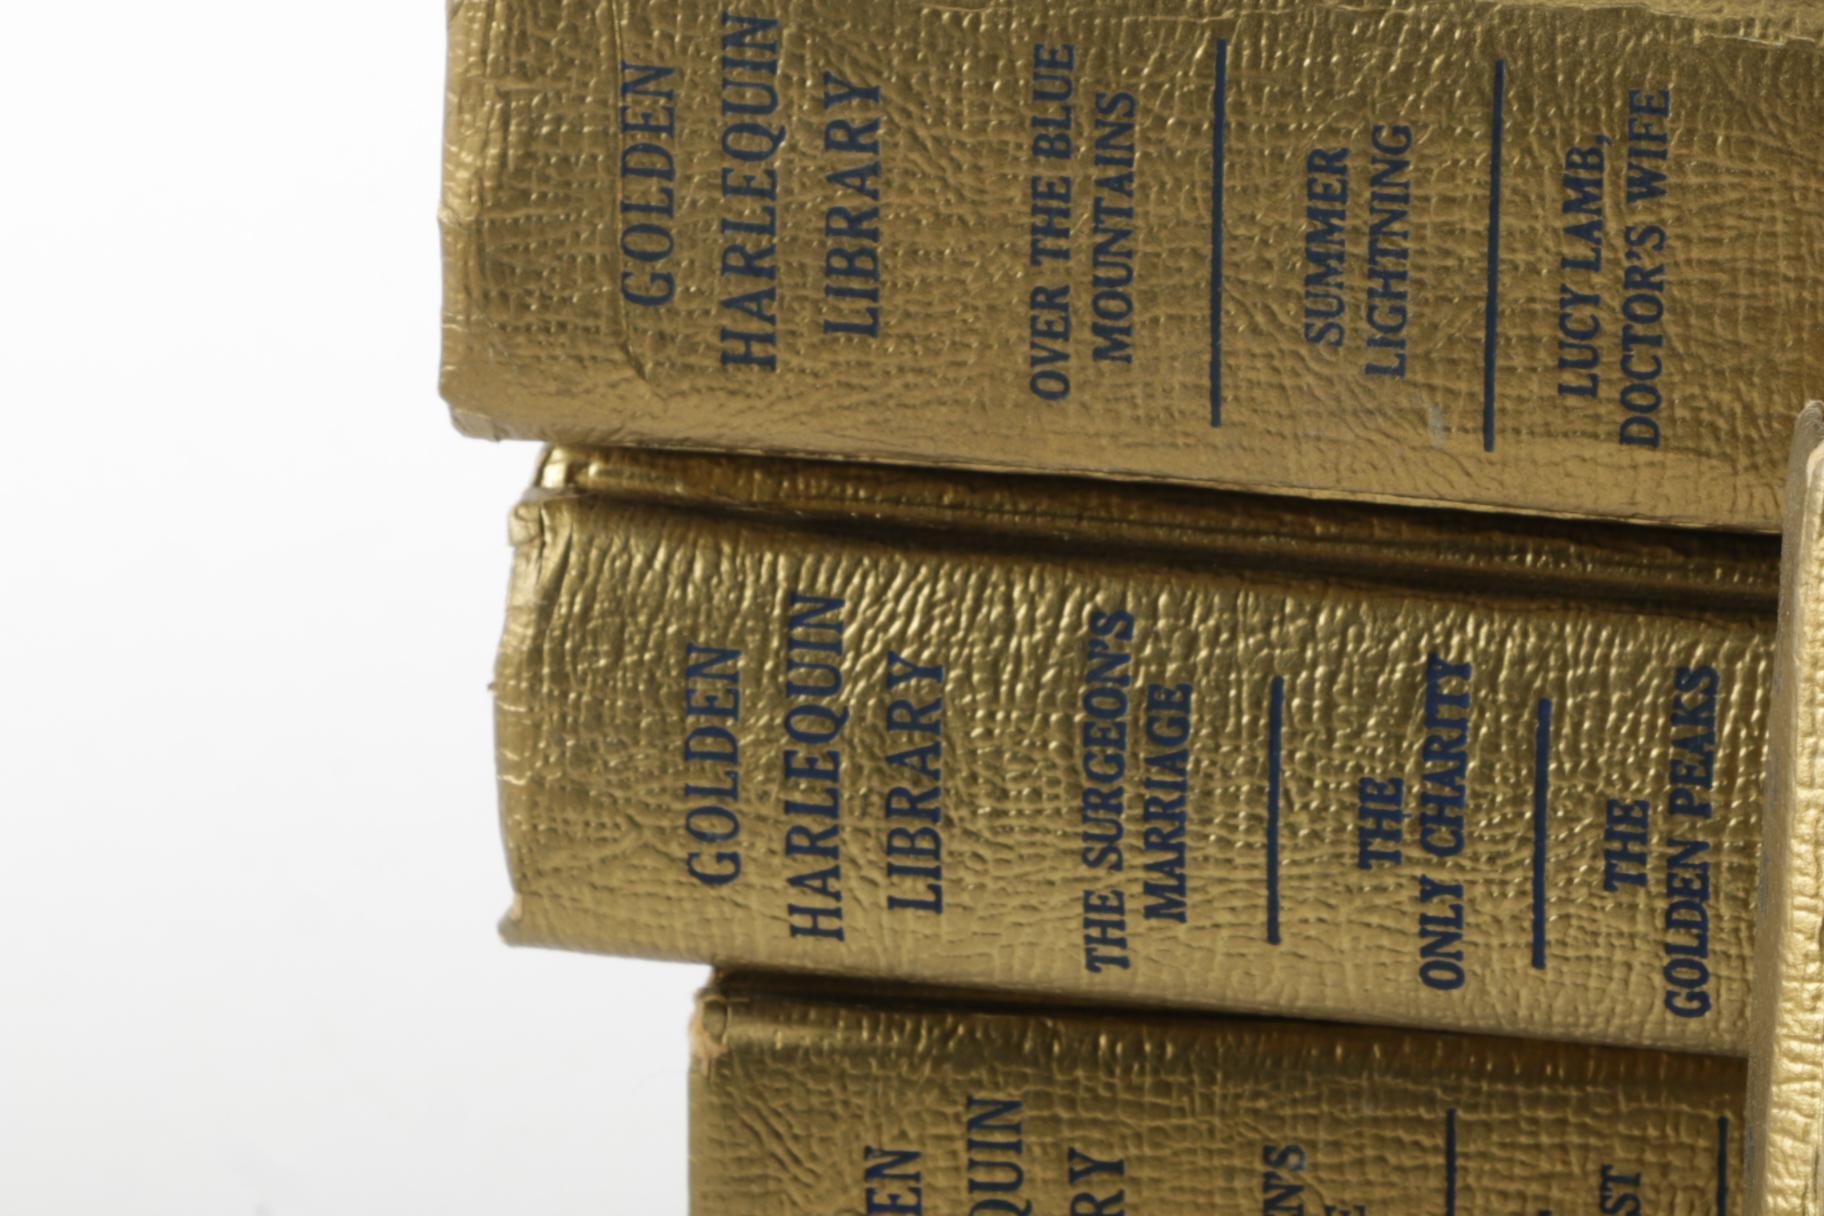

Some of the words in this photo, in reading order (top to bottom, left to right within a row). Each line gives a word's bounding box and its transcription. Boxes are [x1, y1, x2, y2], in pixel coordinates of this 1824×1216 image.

[619, 61, 677, 308] GOLDEN
[720, 11, 787, 370] HARLEQUIN
[1031, 43, 1076, 159] BLUE
[1627, 88, 1671, 204] WIFE
[822, 72, 883, 337] LIBRARY
[1030, 176, 1073, 267] THE
[1092, 91, 1138, 364] MOUNTAINS
[1305, 148, 1351, 348] SUMMER
[1364, 125, 1413, 379] LIGHTNING
[1030, 285, 1072, 401] OVER
[1558, 285, 1602, 399] LUCY
[1619, 225, 1668, 448] DOCTOR'S
[683, 642, 742, 886] GOLDEN
[784, 590, 851, 940] HARLEQUIN
[885, 650, 946, 913] LIBRARY
[1082, 608, 1135, 871] SURGEON'S
[1142, 682, 1193, 922] MARRIAGE
[1358, 777, 1404, 870] THE
[1420, 652, 1472, 857] CHARITY
[1669, 665, 1720, 819] PEAKS
[1083, 889, 1132, 973] THE
[1418, 876, 1466, 990] ONLY
[1604, 799, 1650, 892] THE
[1664, 838, 1712, 1018] GOLDEN
